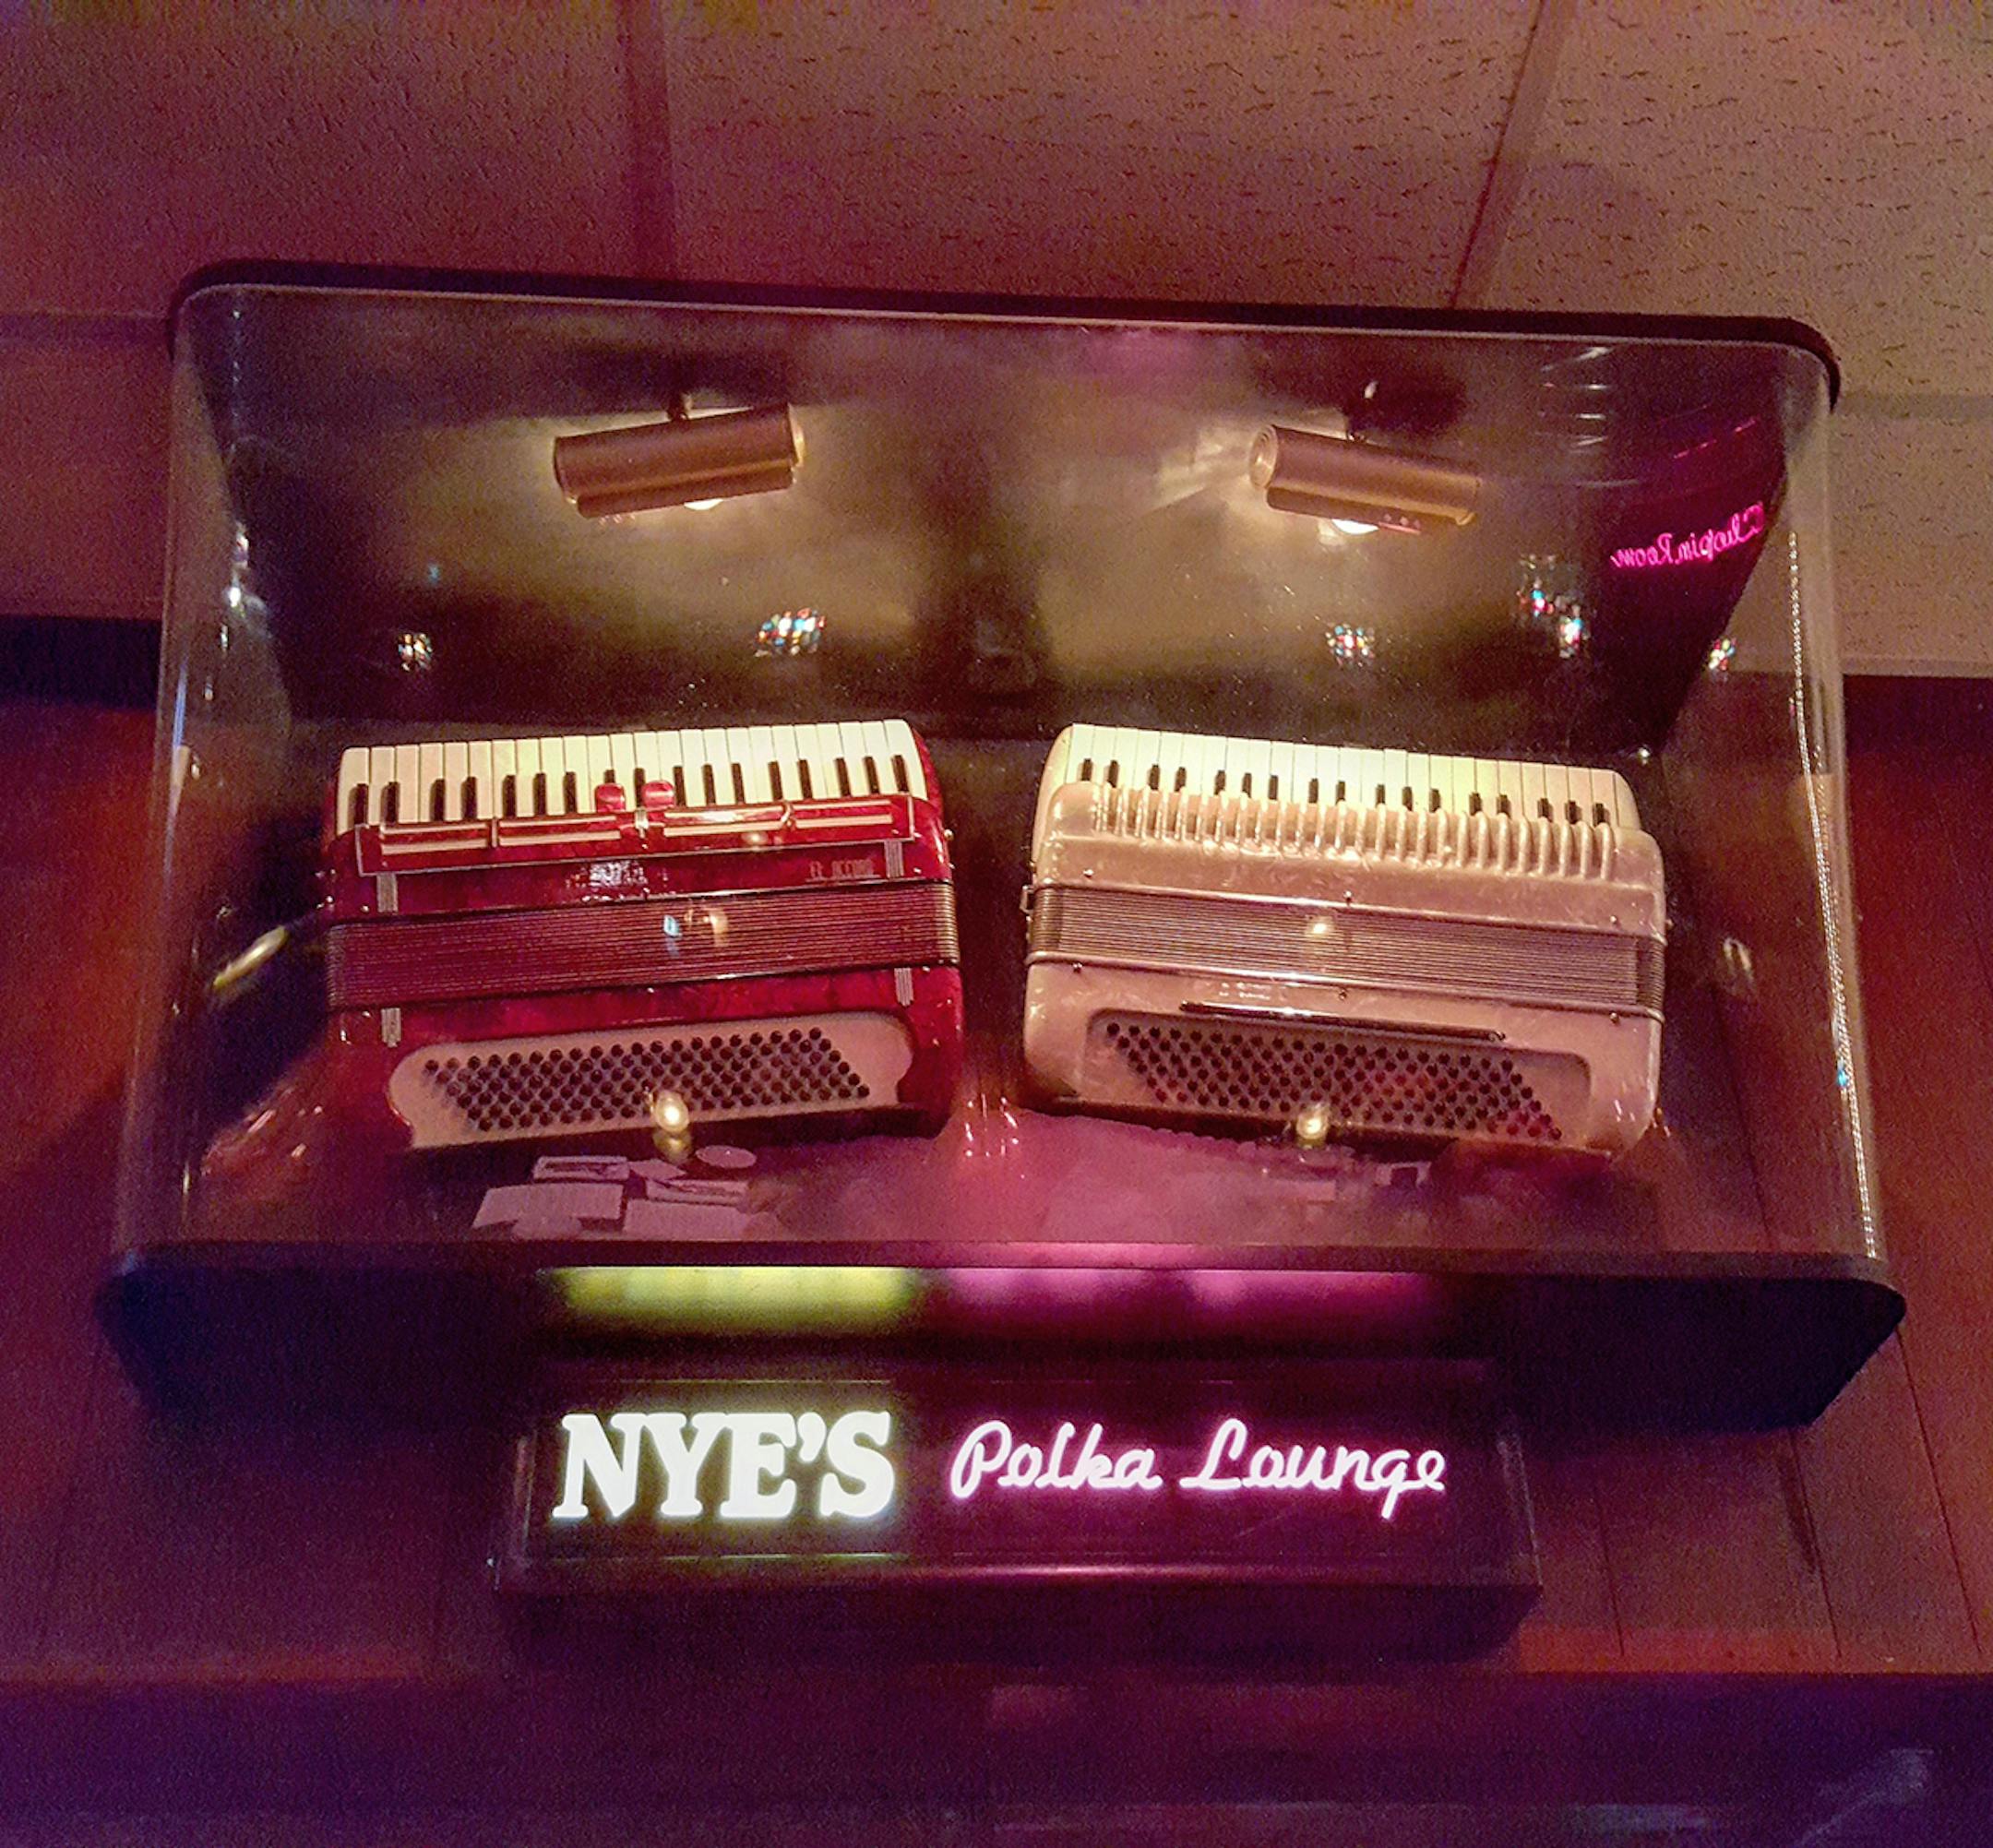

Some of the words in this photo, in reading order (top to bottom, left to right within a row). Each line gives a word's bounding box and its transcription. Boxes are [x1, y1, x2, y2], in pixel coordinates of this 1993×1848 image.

[553, 1411, 895, 1520] NYE'S
[950, 1421, 1163, 1499] Polka
[1179, 1419, 1446, 1519] Lounge
